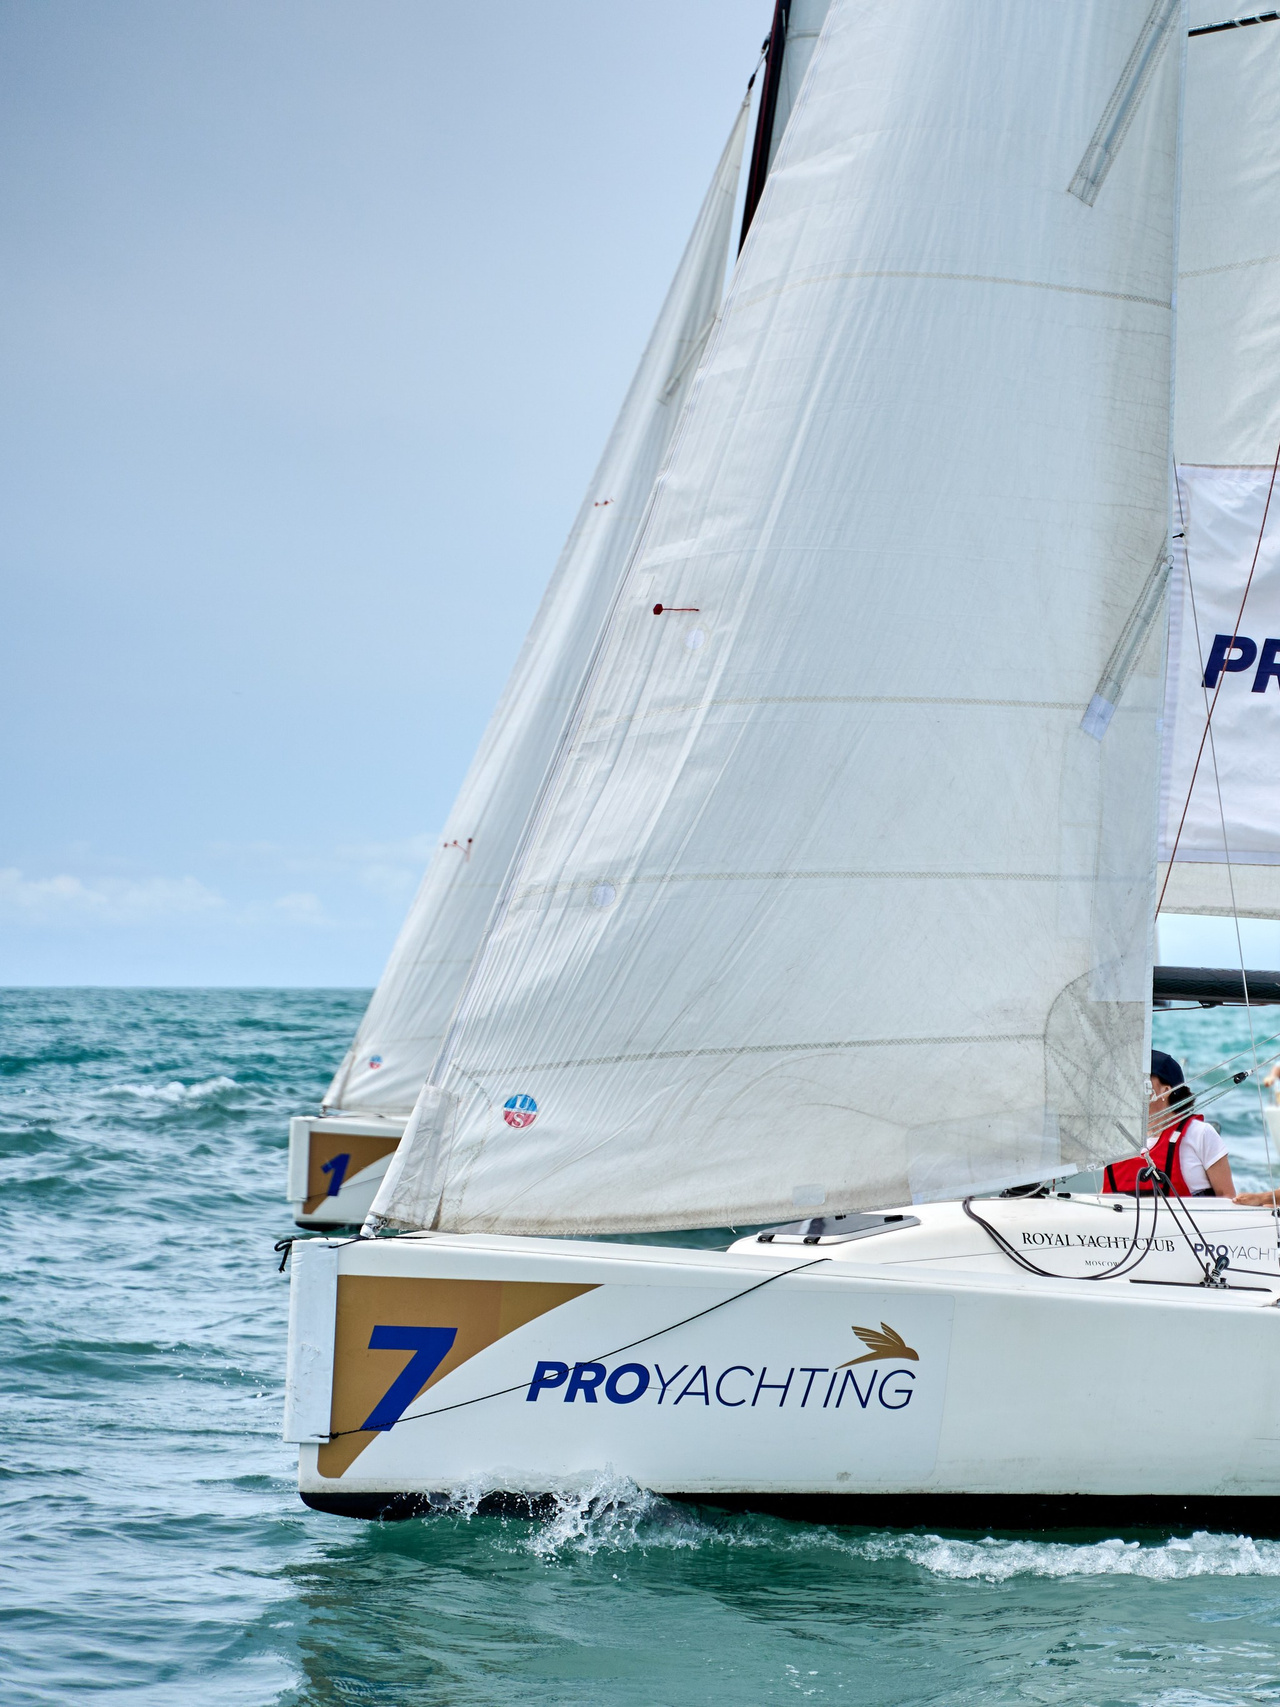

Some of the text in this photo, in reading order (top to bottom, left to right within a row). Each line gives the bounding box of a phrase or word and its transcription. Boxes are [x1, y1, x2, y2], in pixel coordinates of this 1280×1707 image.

[321, 1153, 351, 1197] 1
[1022, 1232, 1175, 1252] ROYAL YACHT CLUB
[359, 1325, 458, 1432] 7
[526, 1360, 917, 1410] PROYACHTING
